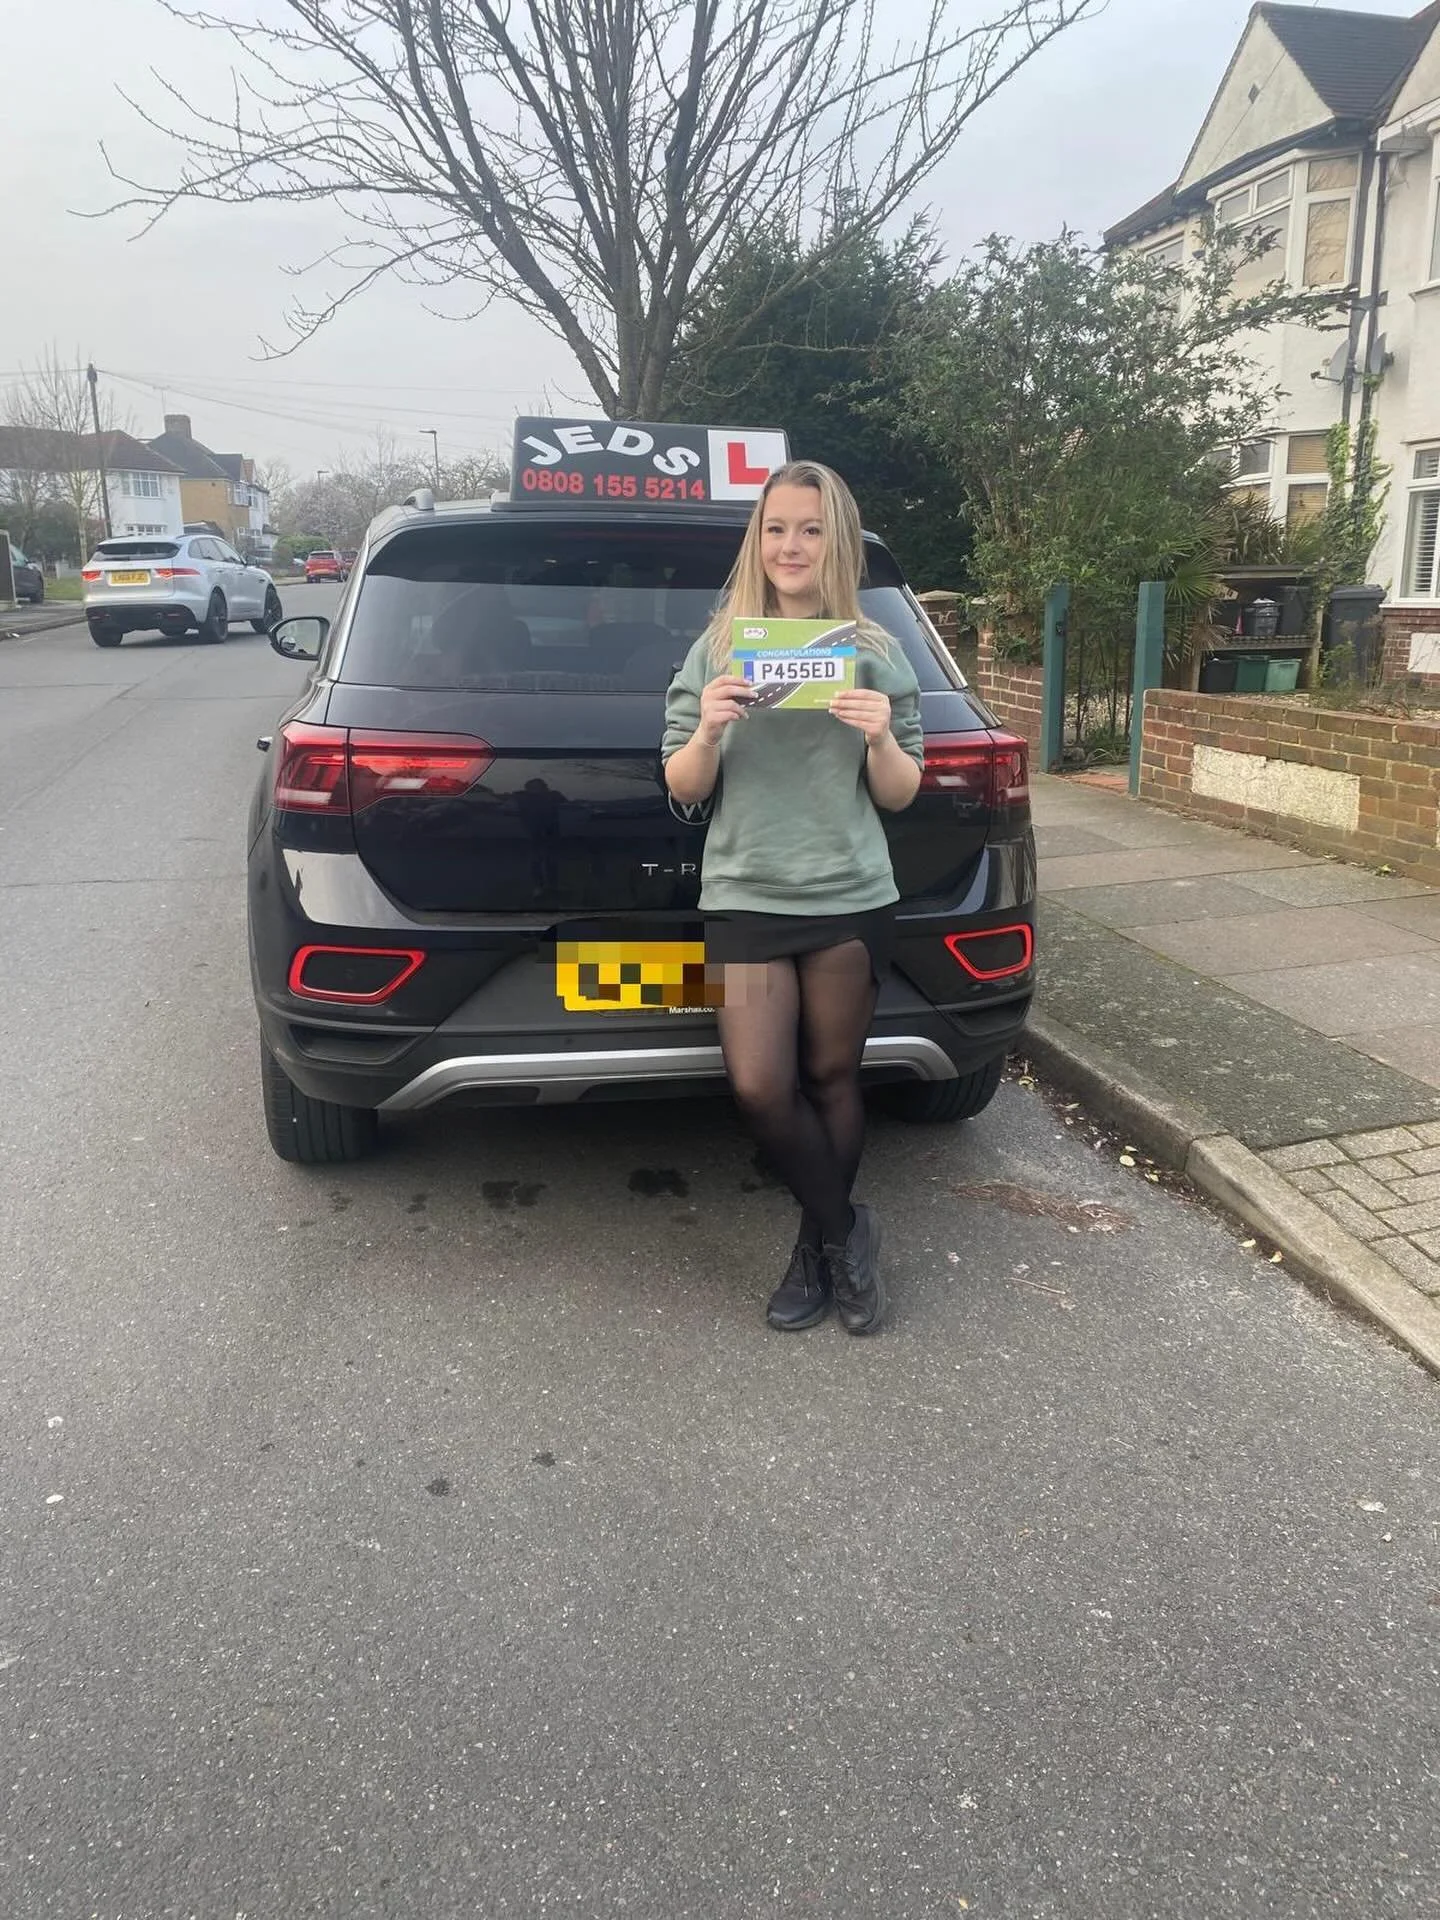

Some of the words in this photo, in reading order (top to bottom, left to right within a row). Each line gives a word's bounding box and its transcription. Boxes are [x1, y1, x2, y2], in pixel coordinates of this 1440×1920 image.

[522, 425, 700, 476] JEDS
[727, 442, 769, 485] L
[522, 470, 584, 494] 0808
[594, 474, 637, 498] 155
[644, 477, 705, 500] 5214
[756, 647, 832, 658] CONGRATULATIONS
[762, 661, 835, 680] P455ED
[641, 863, 697, 877] T-R
